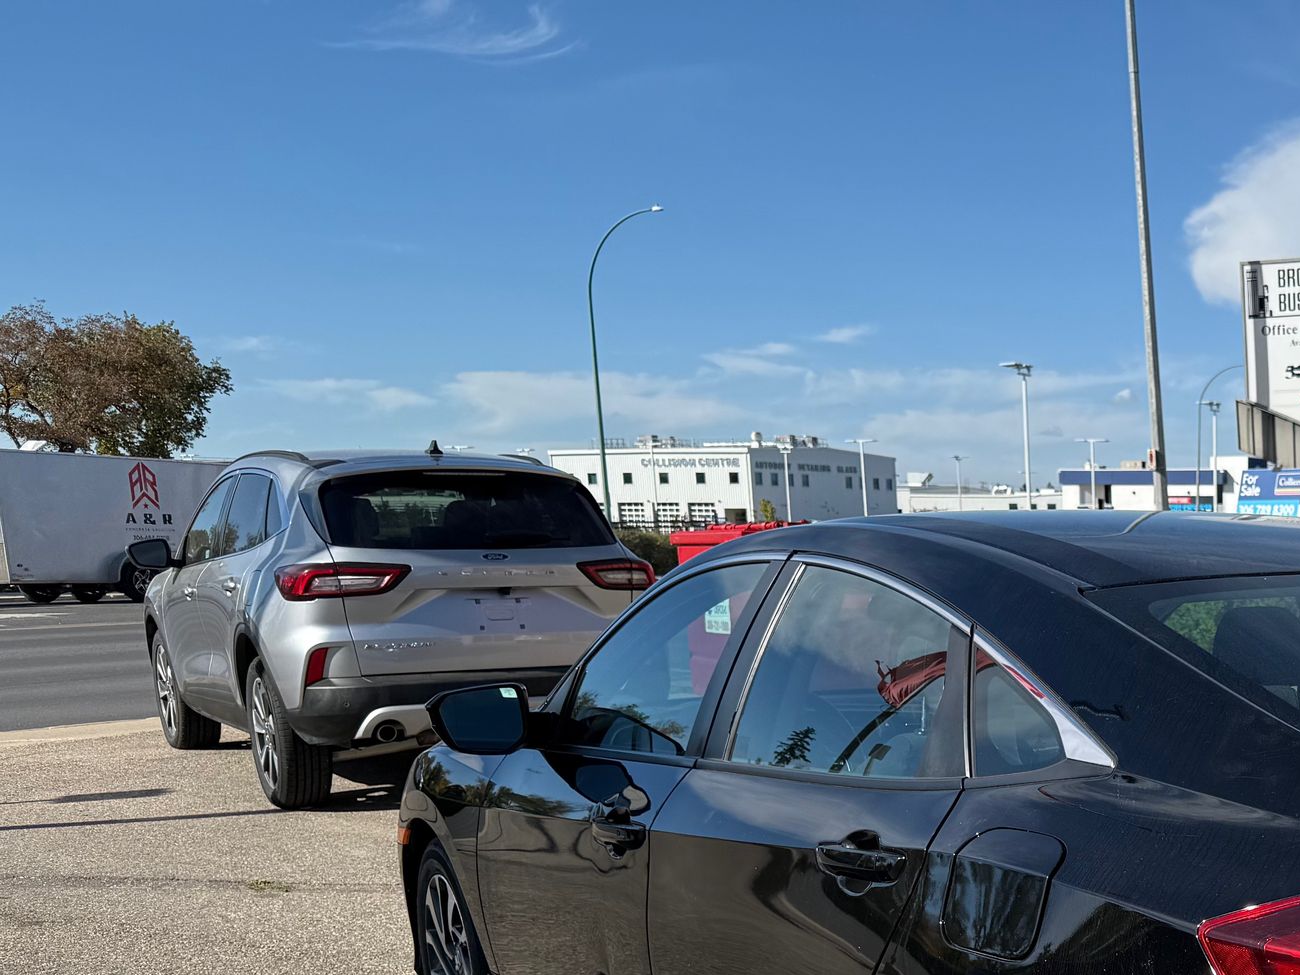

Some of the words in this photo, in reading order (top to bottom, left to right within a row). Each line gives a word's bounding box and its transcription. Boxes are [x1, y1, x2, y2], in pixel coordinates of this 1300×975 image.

[1261, 324, 1298, 337] Office
[641, 457, 697, 469] COLLISION
[698, 457, 740, 468] CENTRE
[1242, 473, 1260, 485] For
[1240, 484, 1261, 497] Sale
[126, 512, 137, 524] A
[143, 513, 156, 525] &
[162, 513, 173, 525] R
